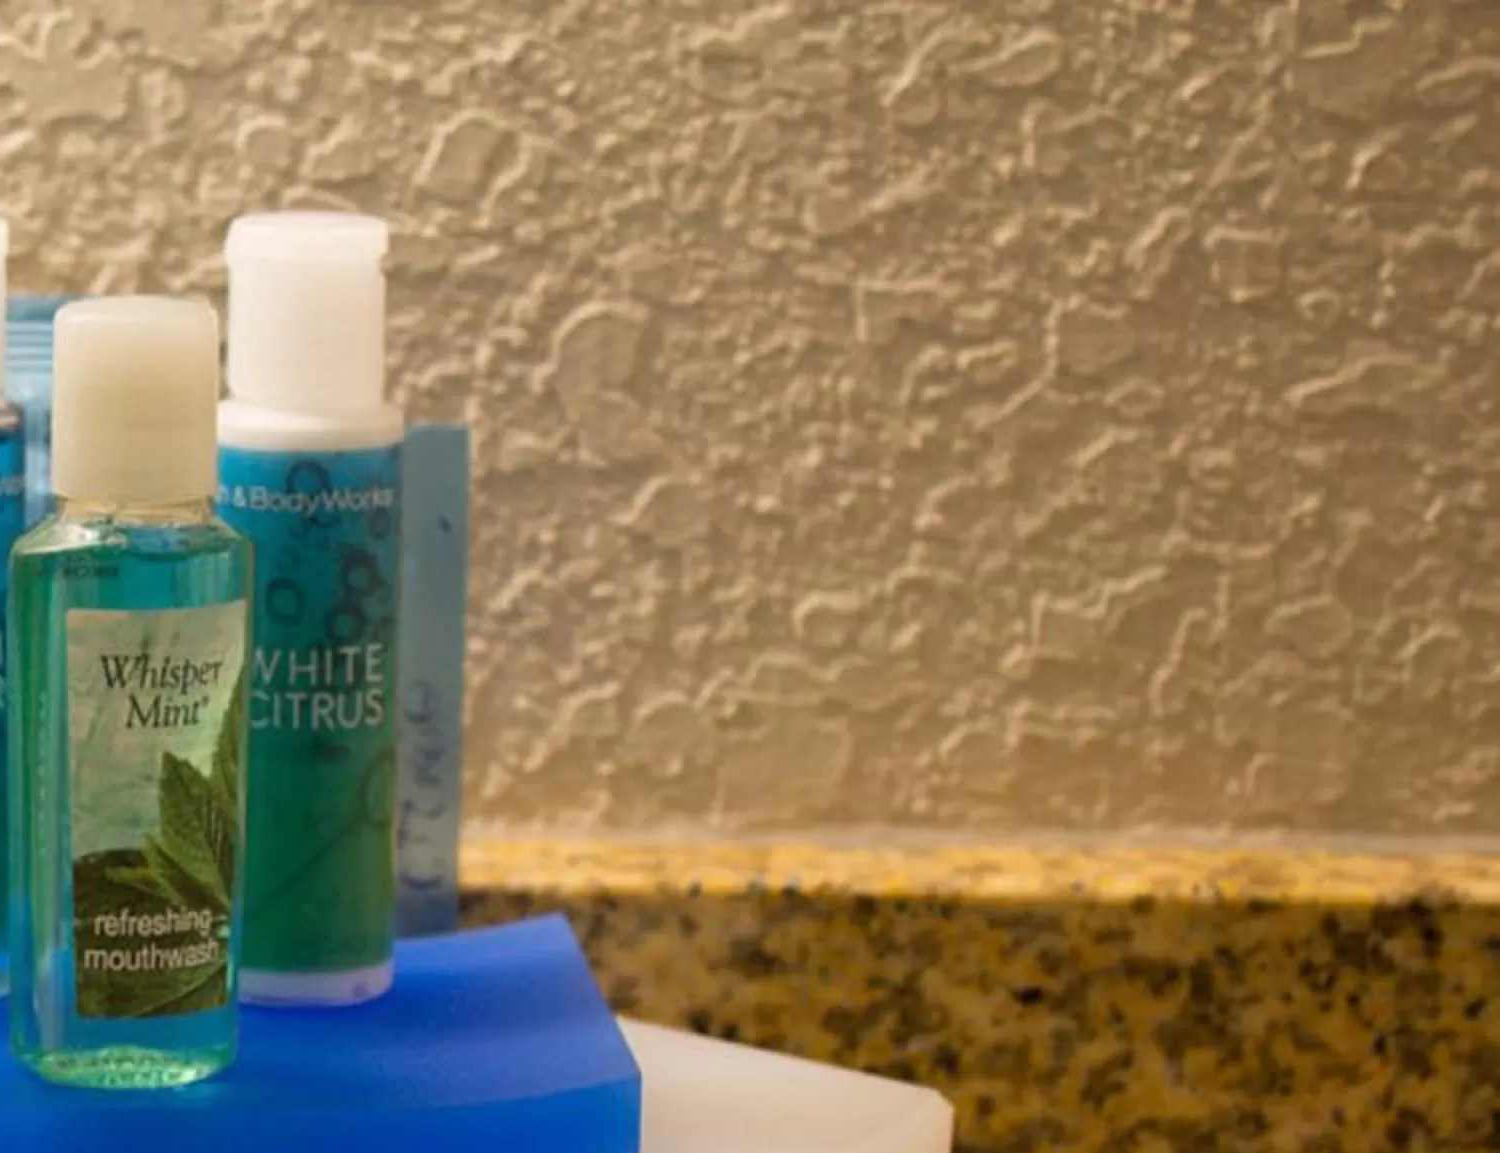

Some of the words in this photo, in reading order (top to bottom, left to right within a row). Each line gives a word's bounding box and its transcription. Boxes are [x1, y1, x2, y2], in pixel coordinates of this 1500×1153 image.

[101, 652, 224, 695] Whisper
[93, 906, 213, 937] refreshing
[84, 939, 220, 971] mouthwash
